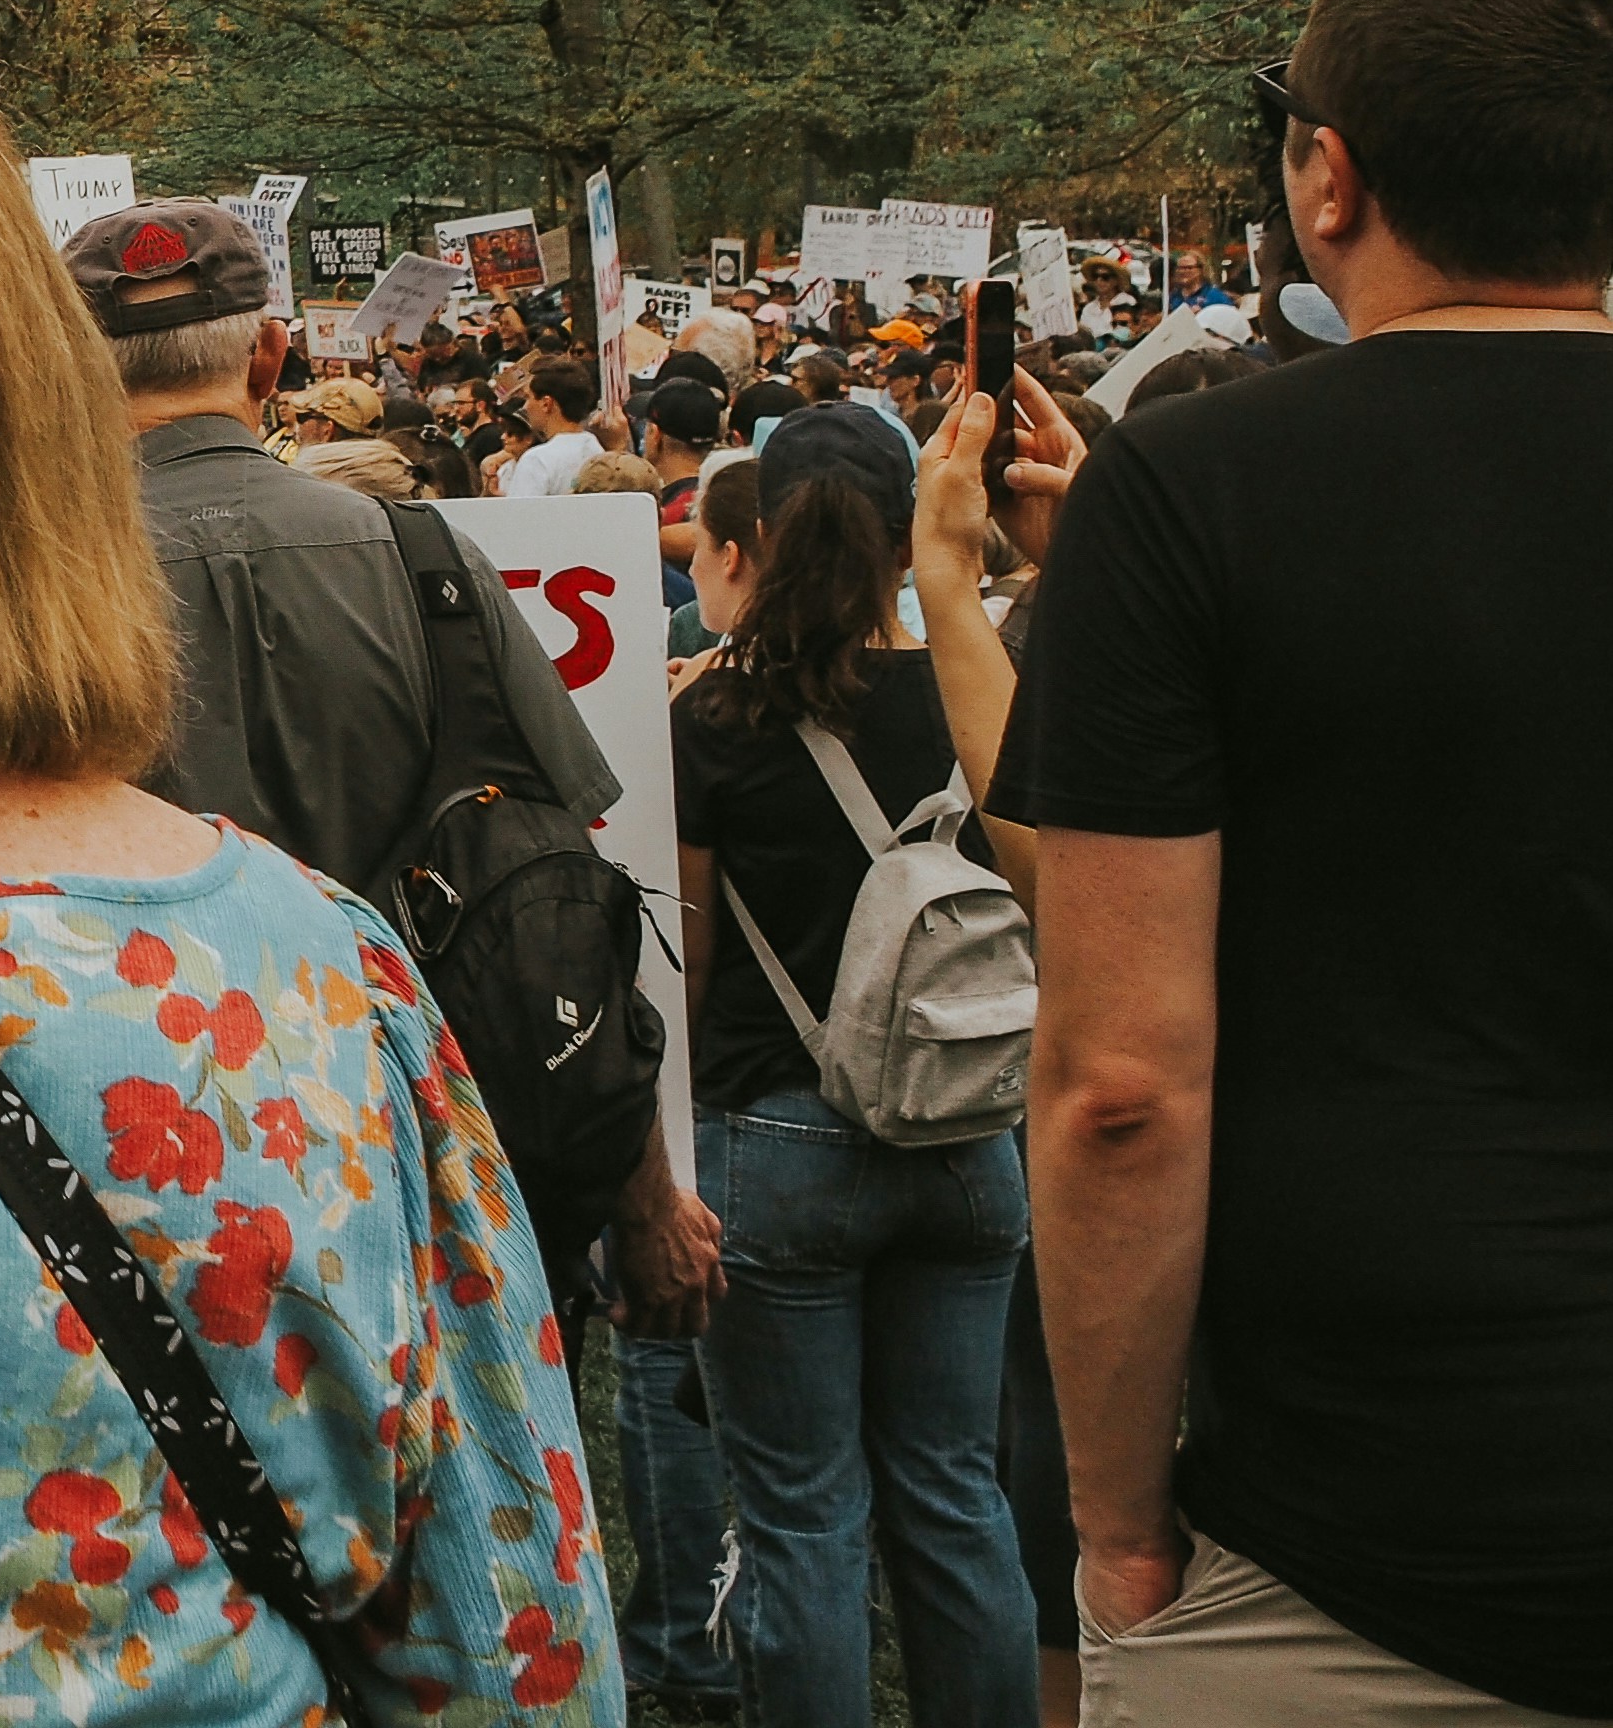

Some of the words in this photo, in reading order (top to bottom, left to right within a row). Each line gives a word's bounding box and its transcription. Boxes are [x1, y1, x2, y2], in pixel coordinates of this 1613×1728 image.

[335, 227, 380, 240] PROCESS
[343, 240, 381, 252] SPEECH
[645, 286, 691, 301] HANDS
[645, 298, 691, 318] OFF!
